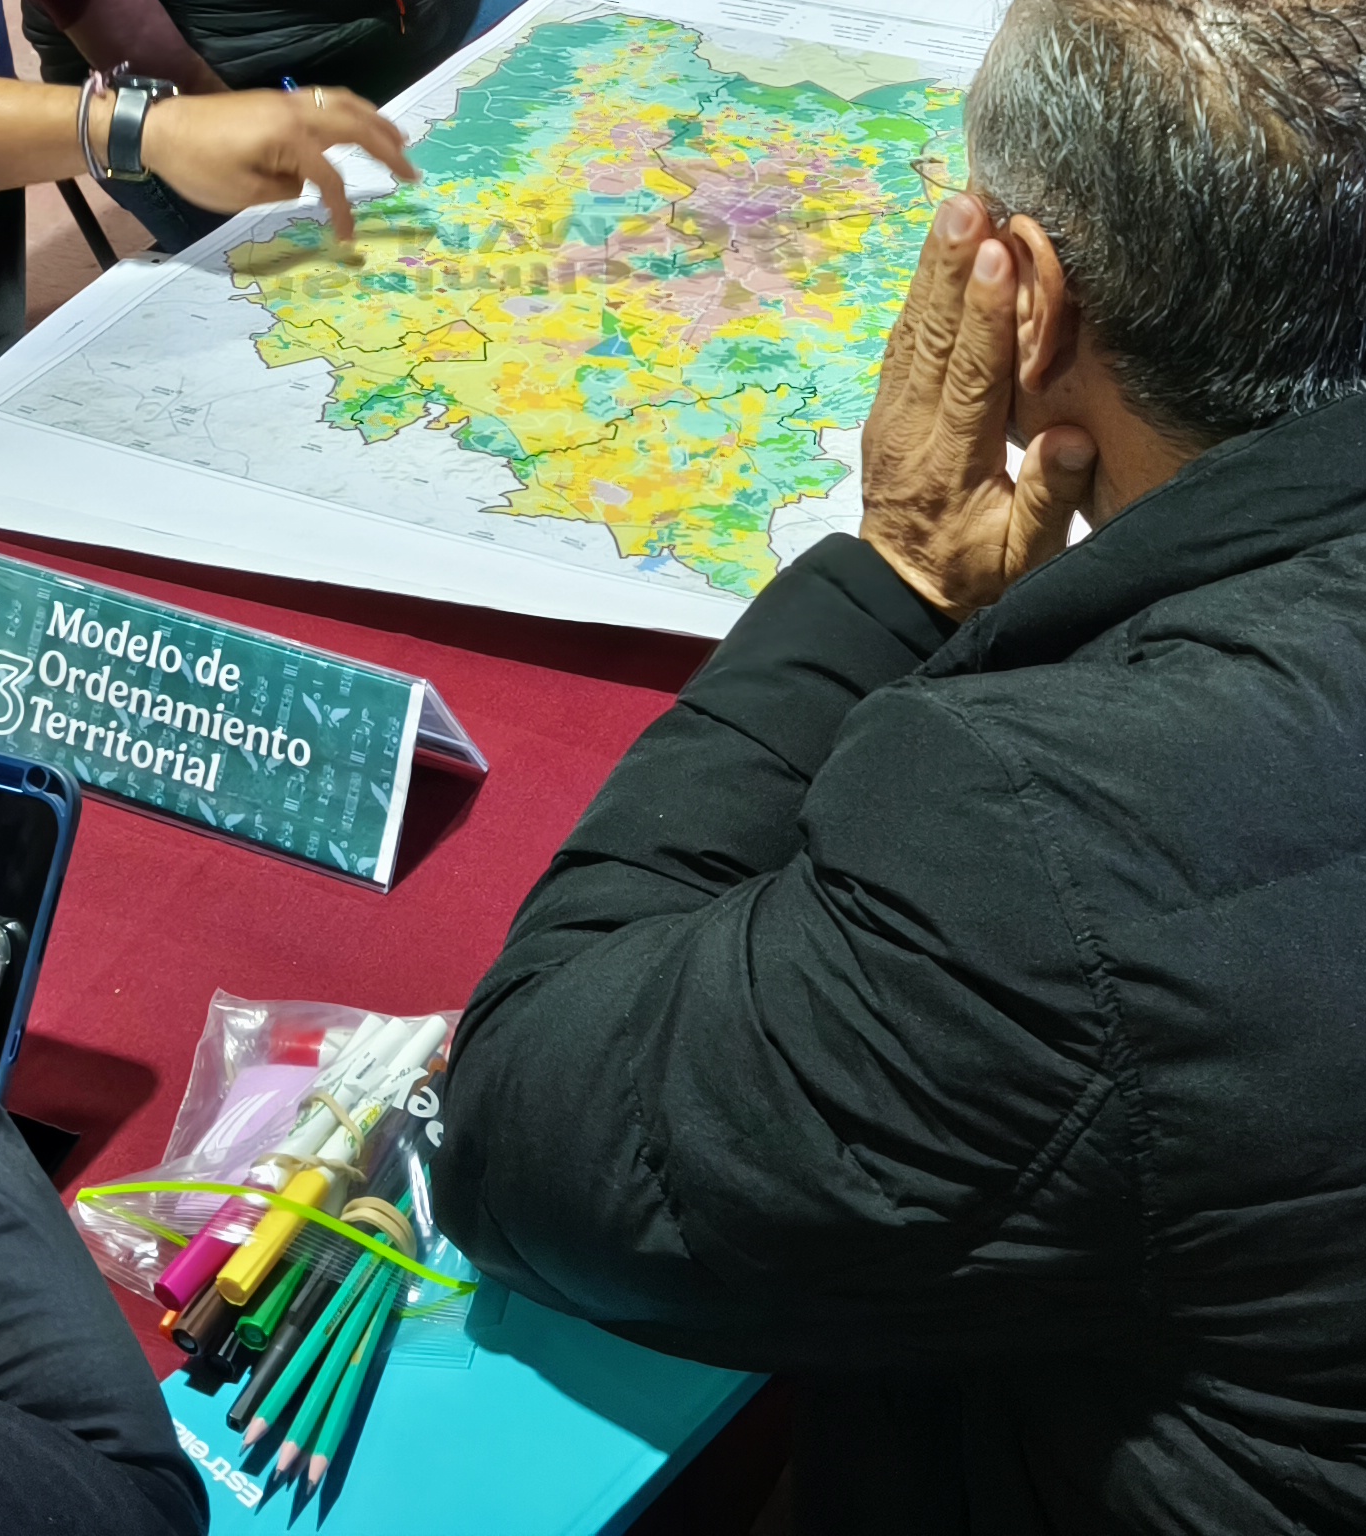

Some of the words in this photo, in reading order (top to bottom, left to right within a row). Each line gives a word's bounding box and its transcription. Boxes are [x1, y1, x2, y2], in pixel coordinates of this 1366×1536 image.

[46, 600, 182, 674] Modelo
[195, 649, 241, 692] de
[29, 695, 223, 793] Territorial
[38, 650, 311, 767] Ordenamiento
